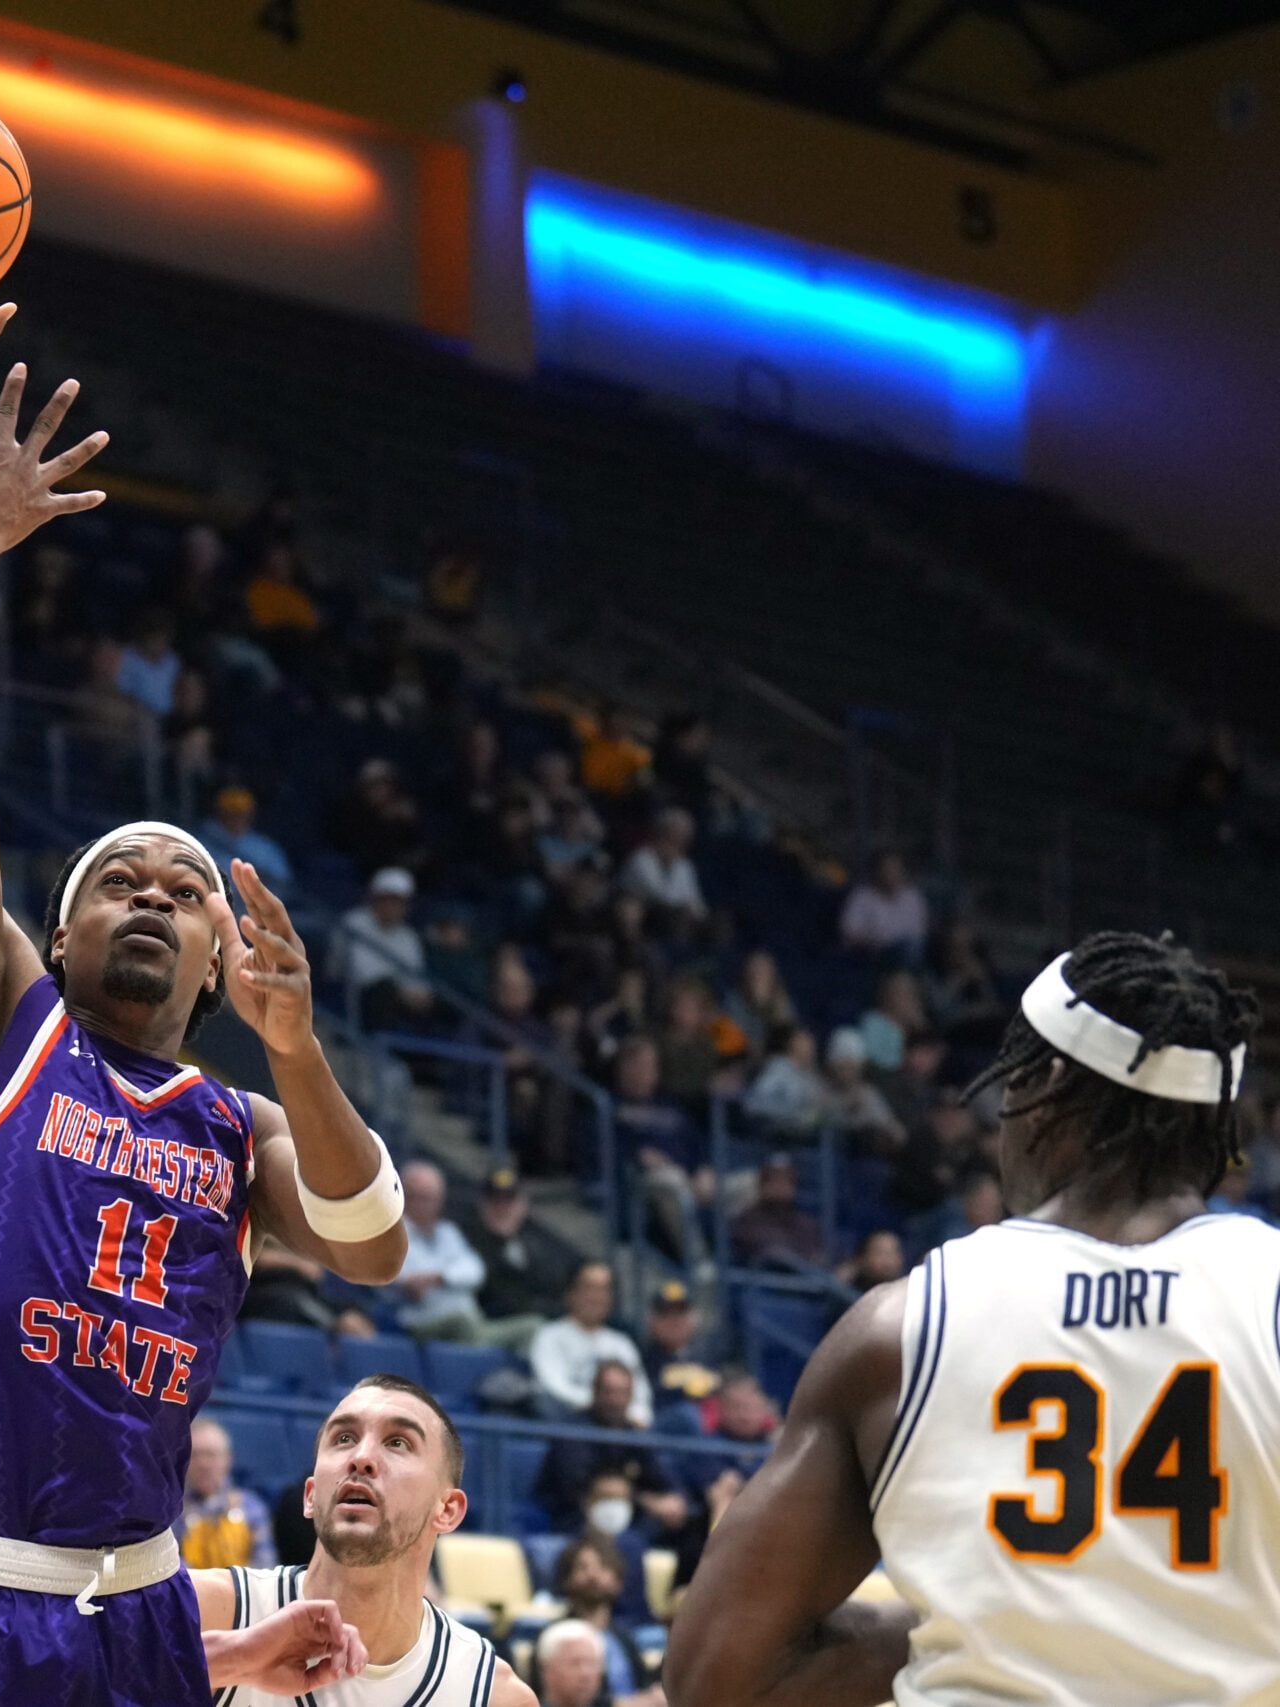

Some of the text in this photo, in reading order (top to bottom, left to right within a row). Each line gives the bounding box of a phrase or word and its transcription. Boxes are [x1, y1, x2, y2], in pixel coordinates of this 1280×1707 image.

[88, 1197, 179, 1309] 11
[1062, 1267, 1180, 1329] DORT
[20, 1297, 198, 1405] STATE
[986, 1359, 1229, 1573] 34
